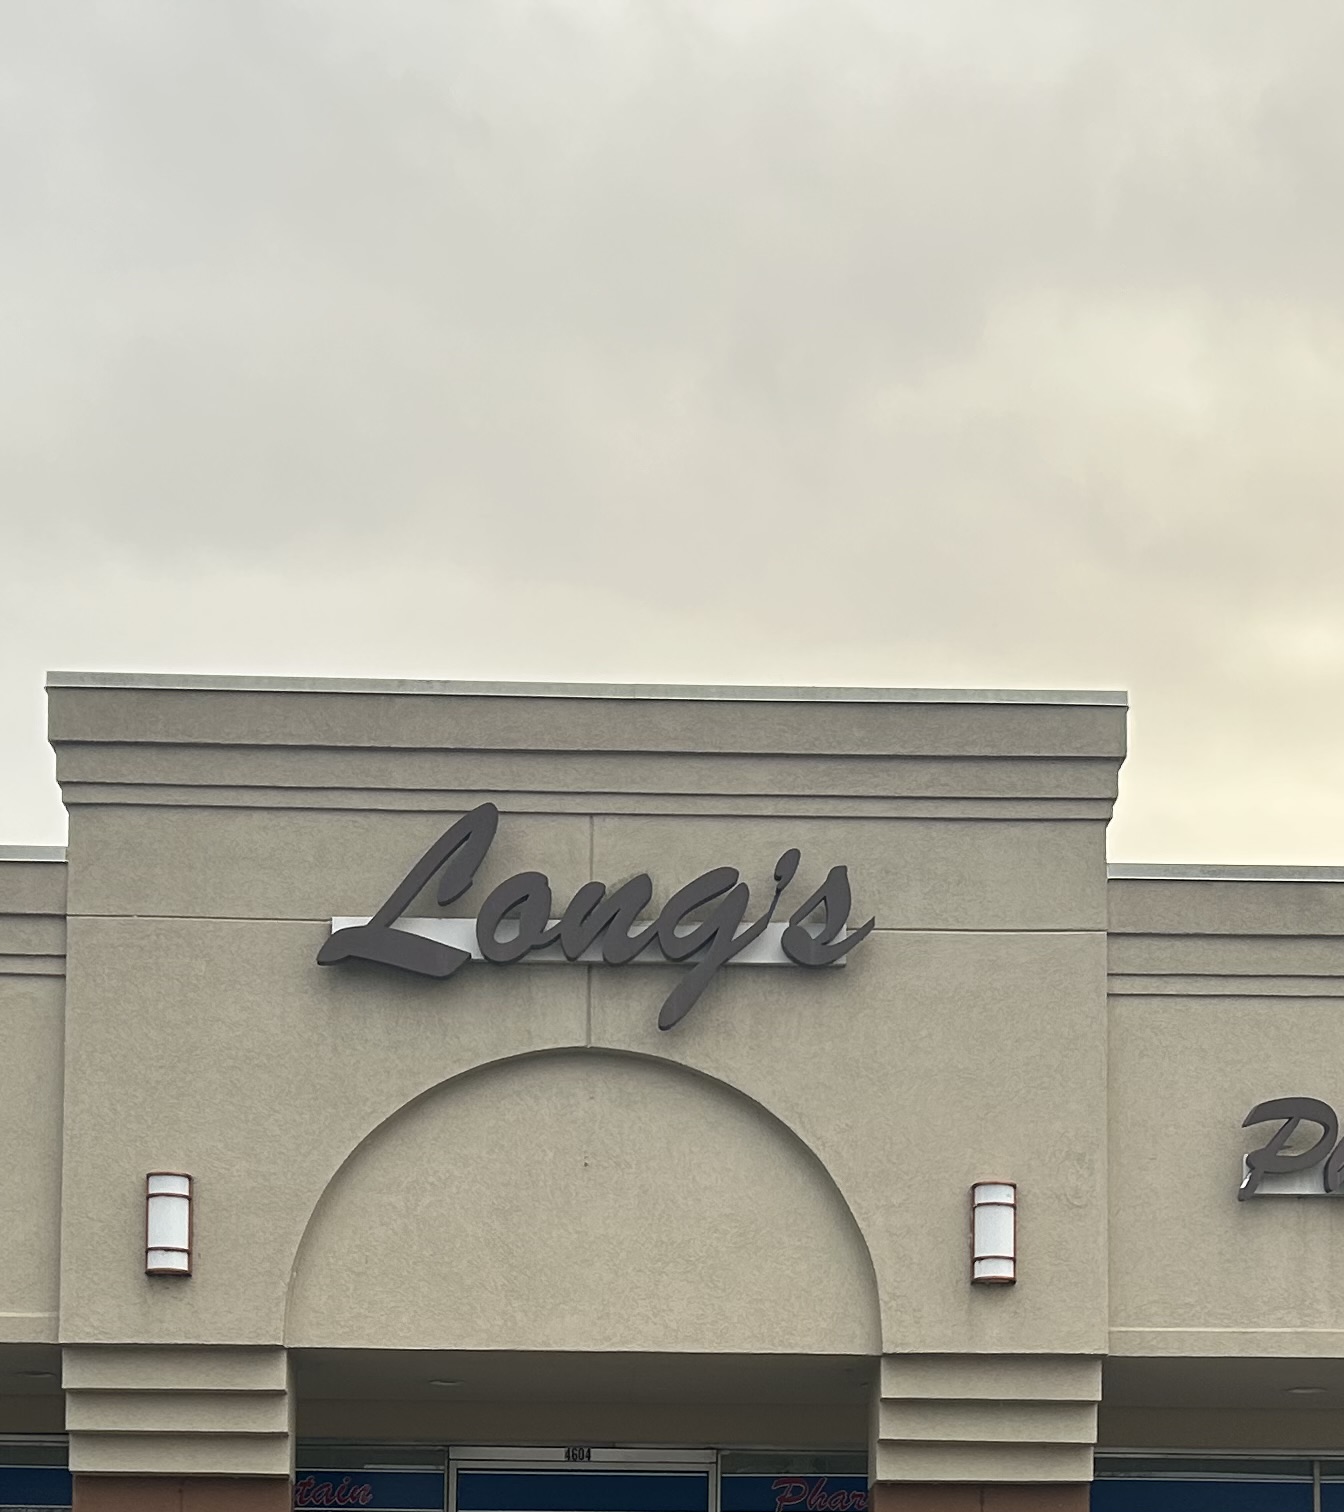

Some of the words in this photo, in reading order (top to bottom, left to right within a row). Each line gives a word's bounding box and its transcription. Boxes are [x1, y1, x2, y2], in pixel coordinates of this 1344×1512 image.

[317, 801, 875, 1032] Long's
[564, 1447, 592, 1461] 4604
[294, 1475, 374, 1506] tain
[771, 1477, 869, 1512] Phar
